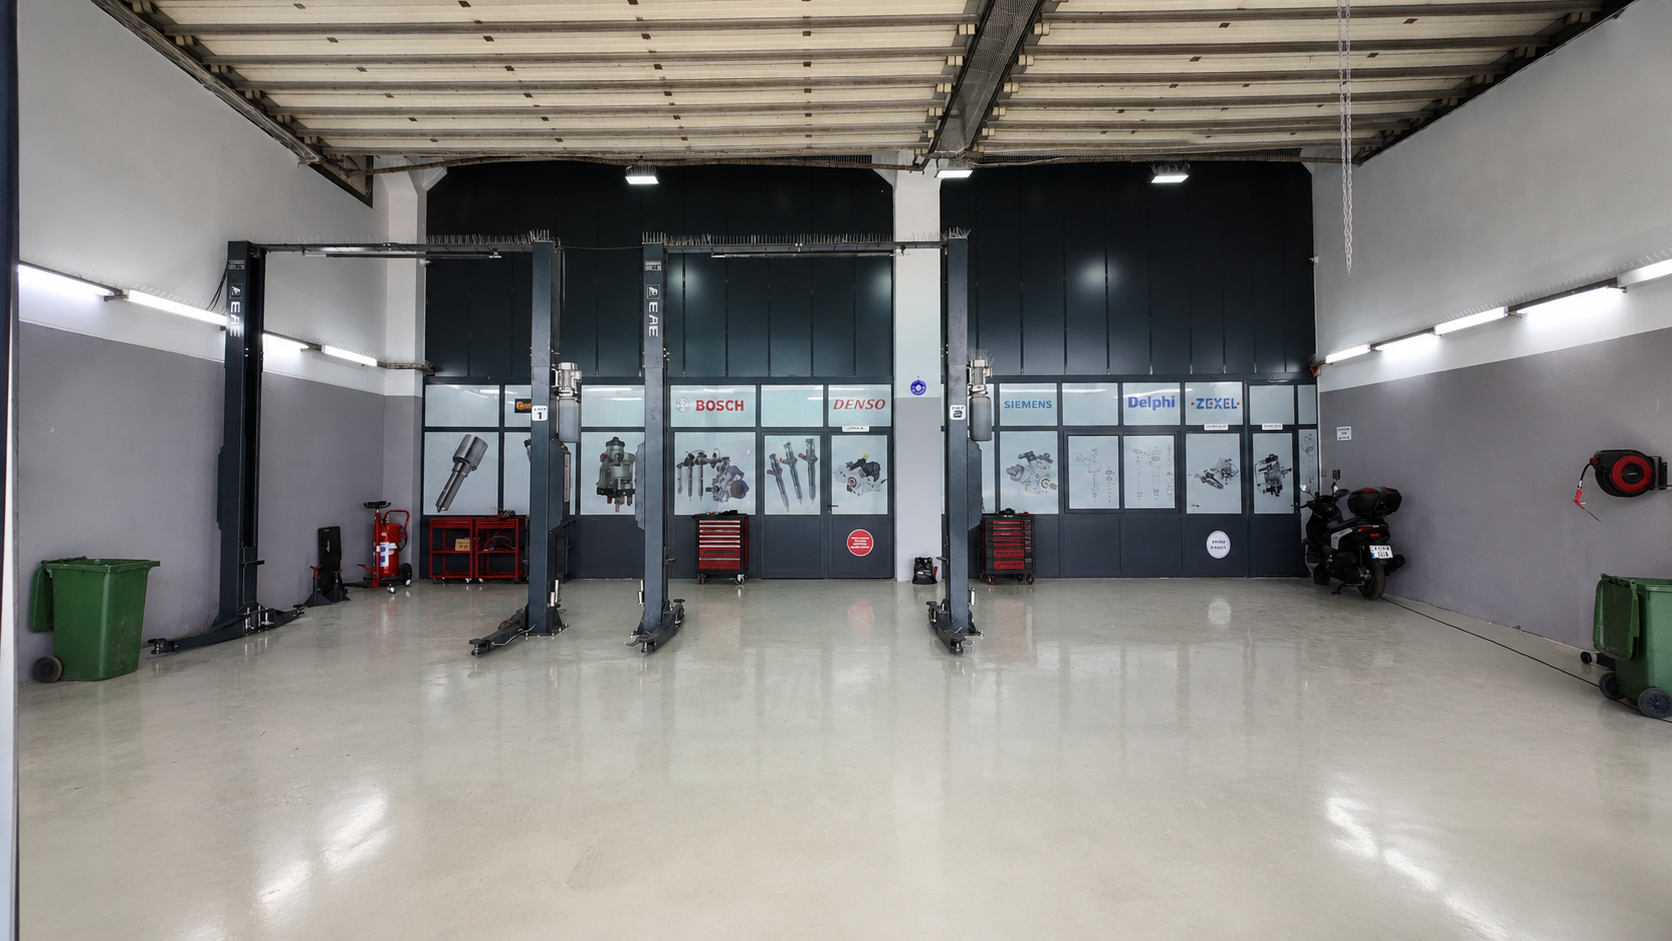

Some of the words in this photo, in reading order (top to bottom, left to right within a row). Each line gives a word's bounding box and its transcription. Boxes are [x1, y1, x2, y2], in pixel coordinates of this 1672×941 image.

[230, 301, 241, 337] EAE
[648, 301, 659, 337] EAE
[695, 399, 745, 412] BOSCH
[833, 398, 886, 410] DENSO
[1003, 400, 1053, 409] SIEMENS
[1128, 395, 1175, 411] Delphi
[1195, 397, 1238, 410] ZEXEL
[537, 411, 542, 420] 1
